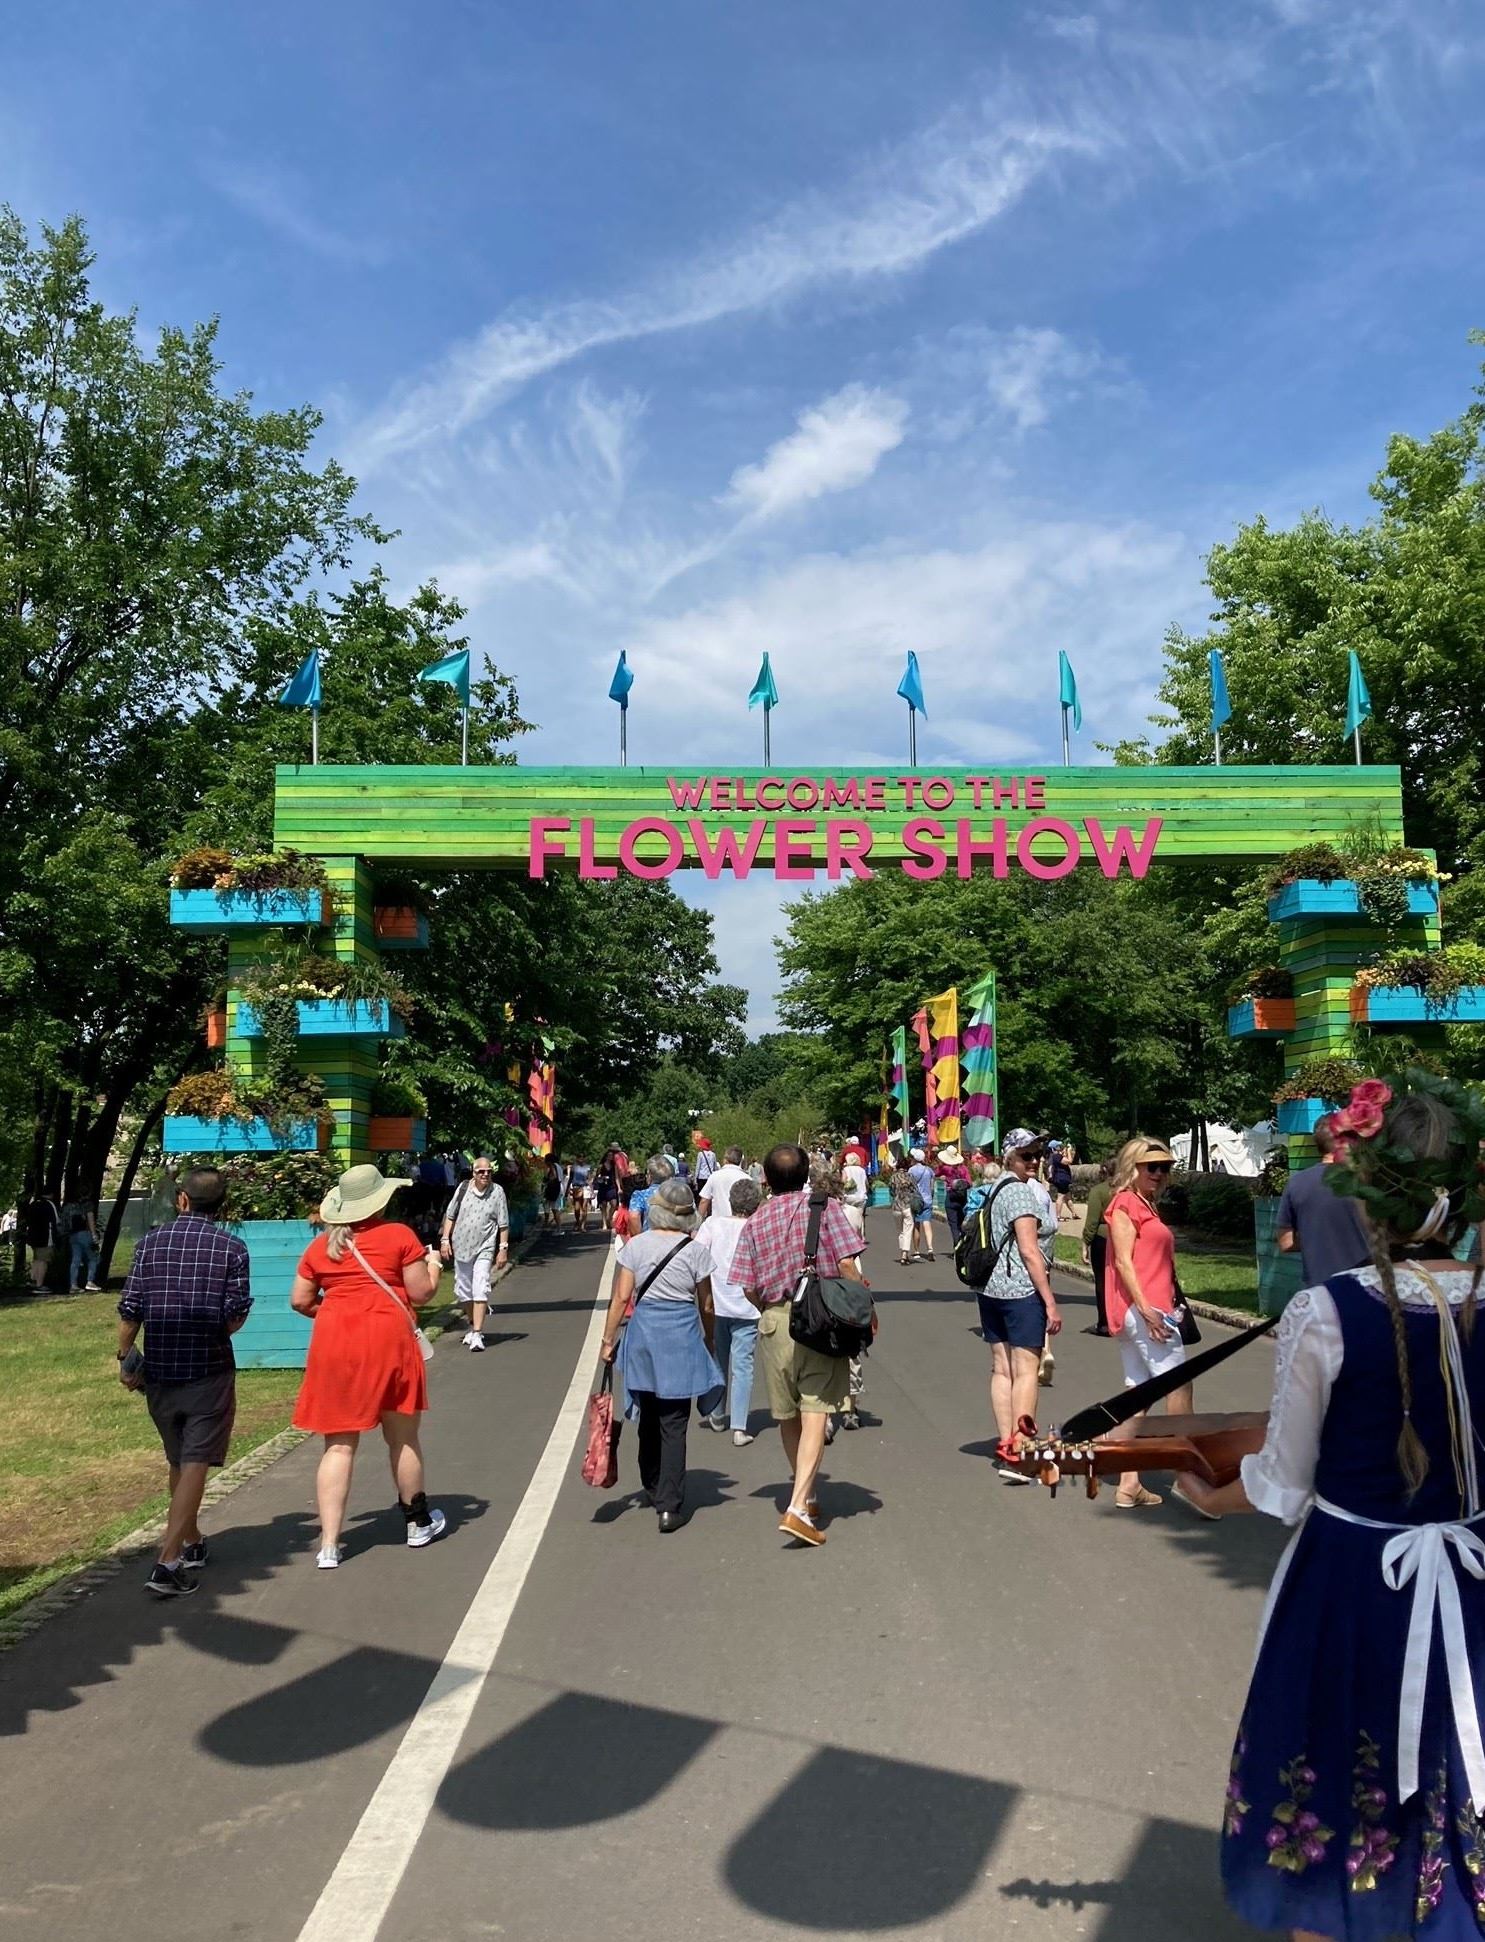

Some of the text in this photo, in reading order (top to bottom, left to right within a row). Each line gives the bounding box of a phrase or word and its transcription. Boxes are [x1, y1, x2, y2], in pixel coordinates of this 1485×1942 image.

[668, 776, 1045, 810] WELCOME TO THE
[529, 818, 1163, 881] FLOWER SHOW
